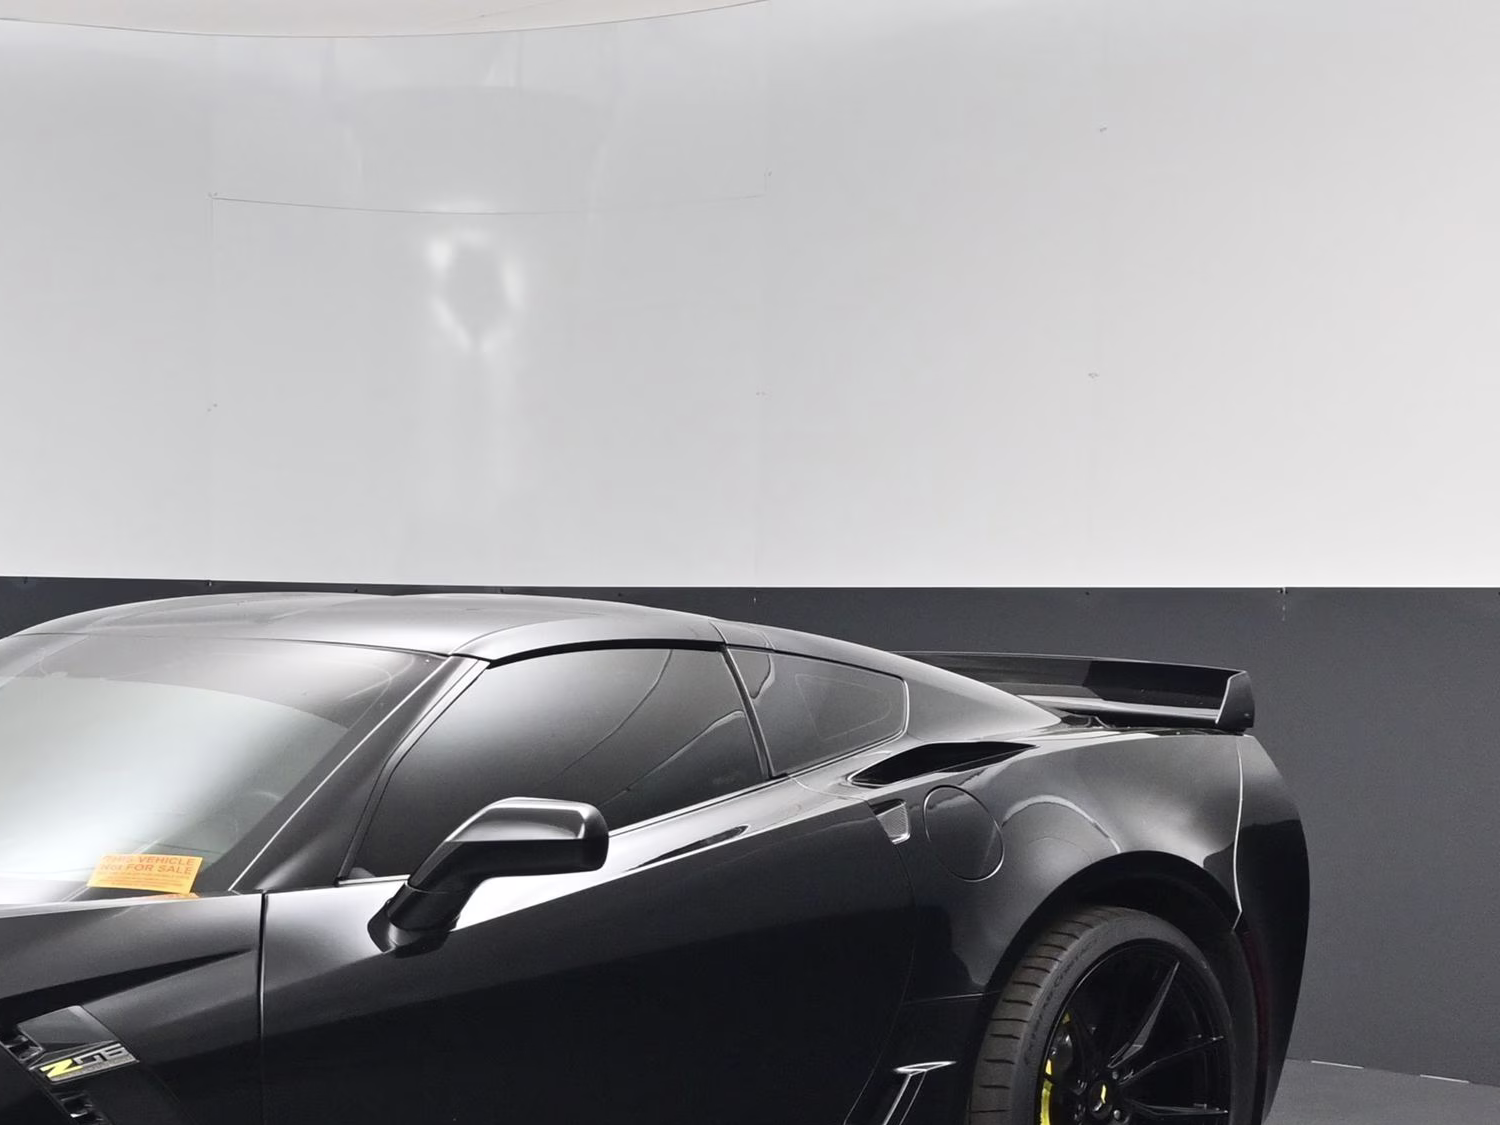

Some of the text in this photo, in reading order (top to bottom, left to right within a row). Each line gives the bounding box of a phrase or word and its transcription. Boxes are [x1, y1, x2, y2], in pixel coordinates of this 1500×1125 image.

[102, 855, 196, 866] THIS VEHICLE
[126, 864, 154, 872] FOR
[158, 865, 193, 875] SALE
[39, 1043, 134, 1079] Z06
